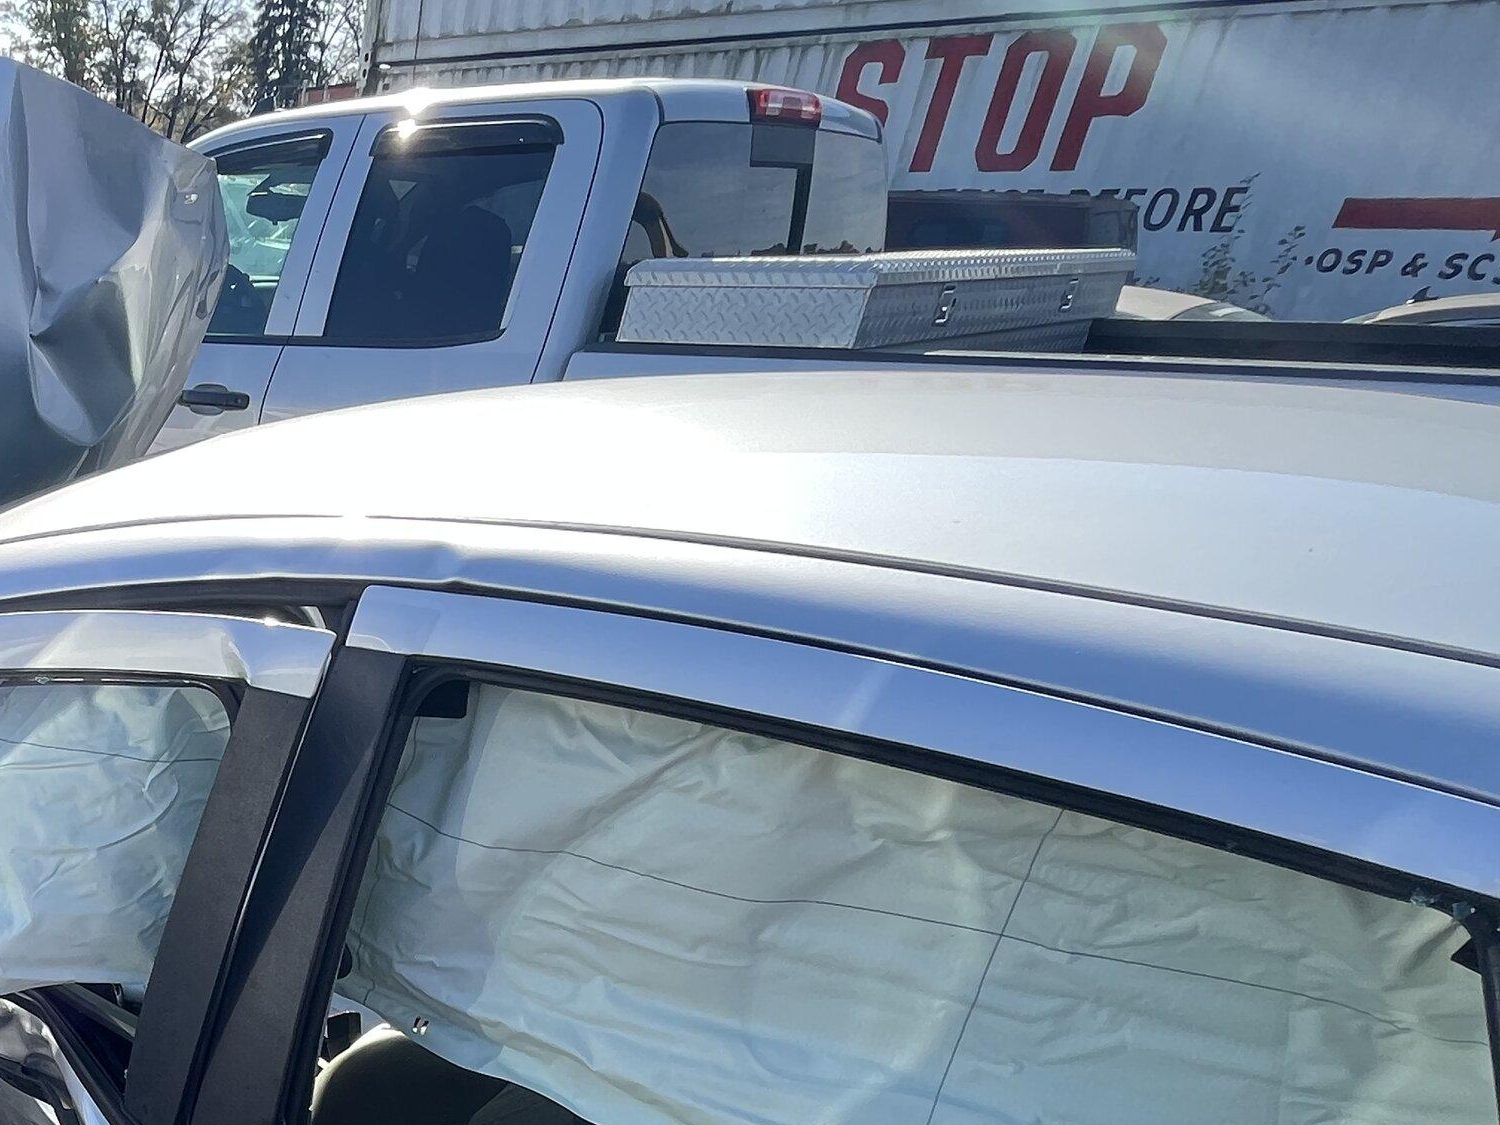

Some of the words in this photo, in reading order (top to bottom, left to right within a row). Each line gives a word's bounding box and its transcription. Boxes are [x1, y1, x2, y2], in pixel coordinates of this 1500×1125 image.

[836, 23, 1168, 172] STOP
[1401, 252, 1428, 277] &
[1437, 252, 1500, 284] SC
